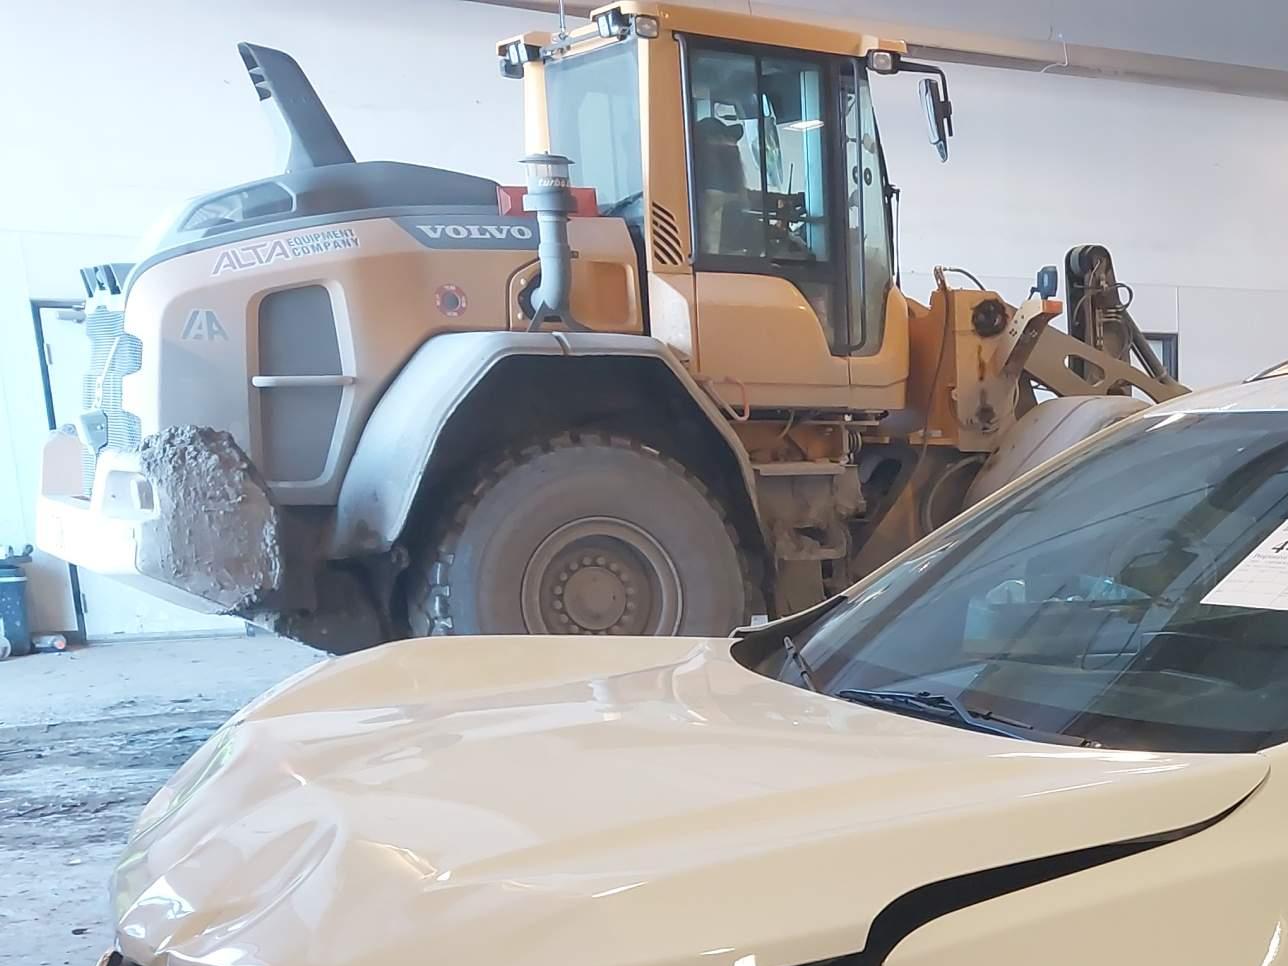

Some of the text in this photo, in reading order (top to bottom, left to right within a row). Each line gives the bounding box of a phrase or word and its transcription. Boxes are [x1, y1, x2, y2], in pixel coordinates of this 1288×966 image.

[287, 228, 355, 247] EQUIPMENT
[415, 224, 533, 240] VOLVO
[291, 237, 361, 257] COMPANY
[211, 239, 291, 275] ALTA
